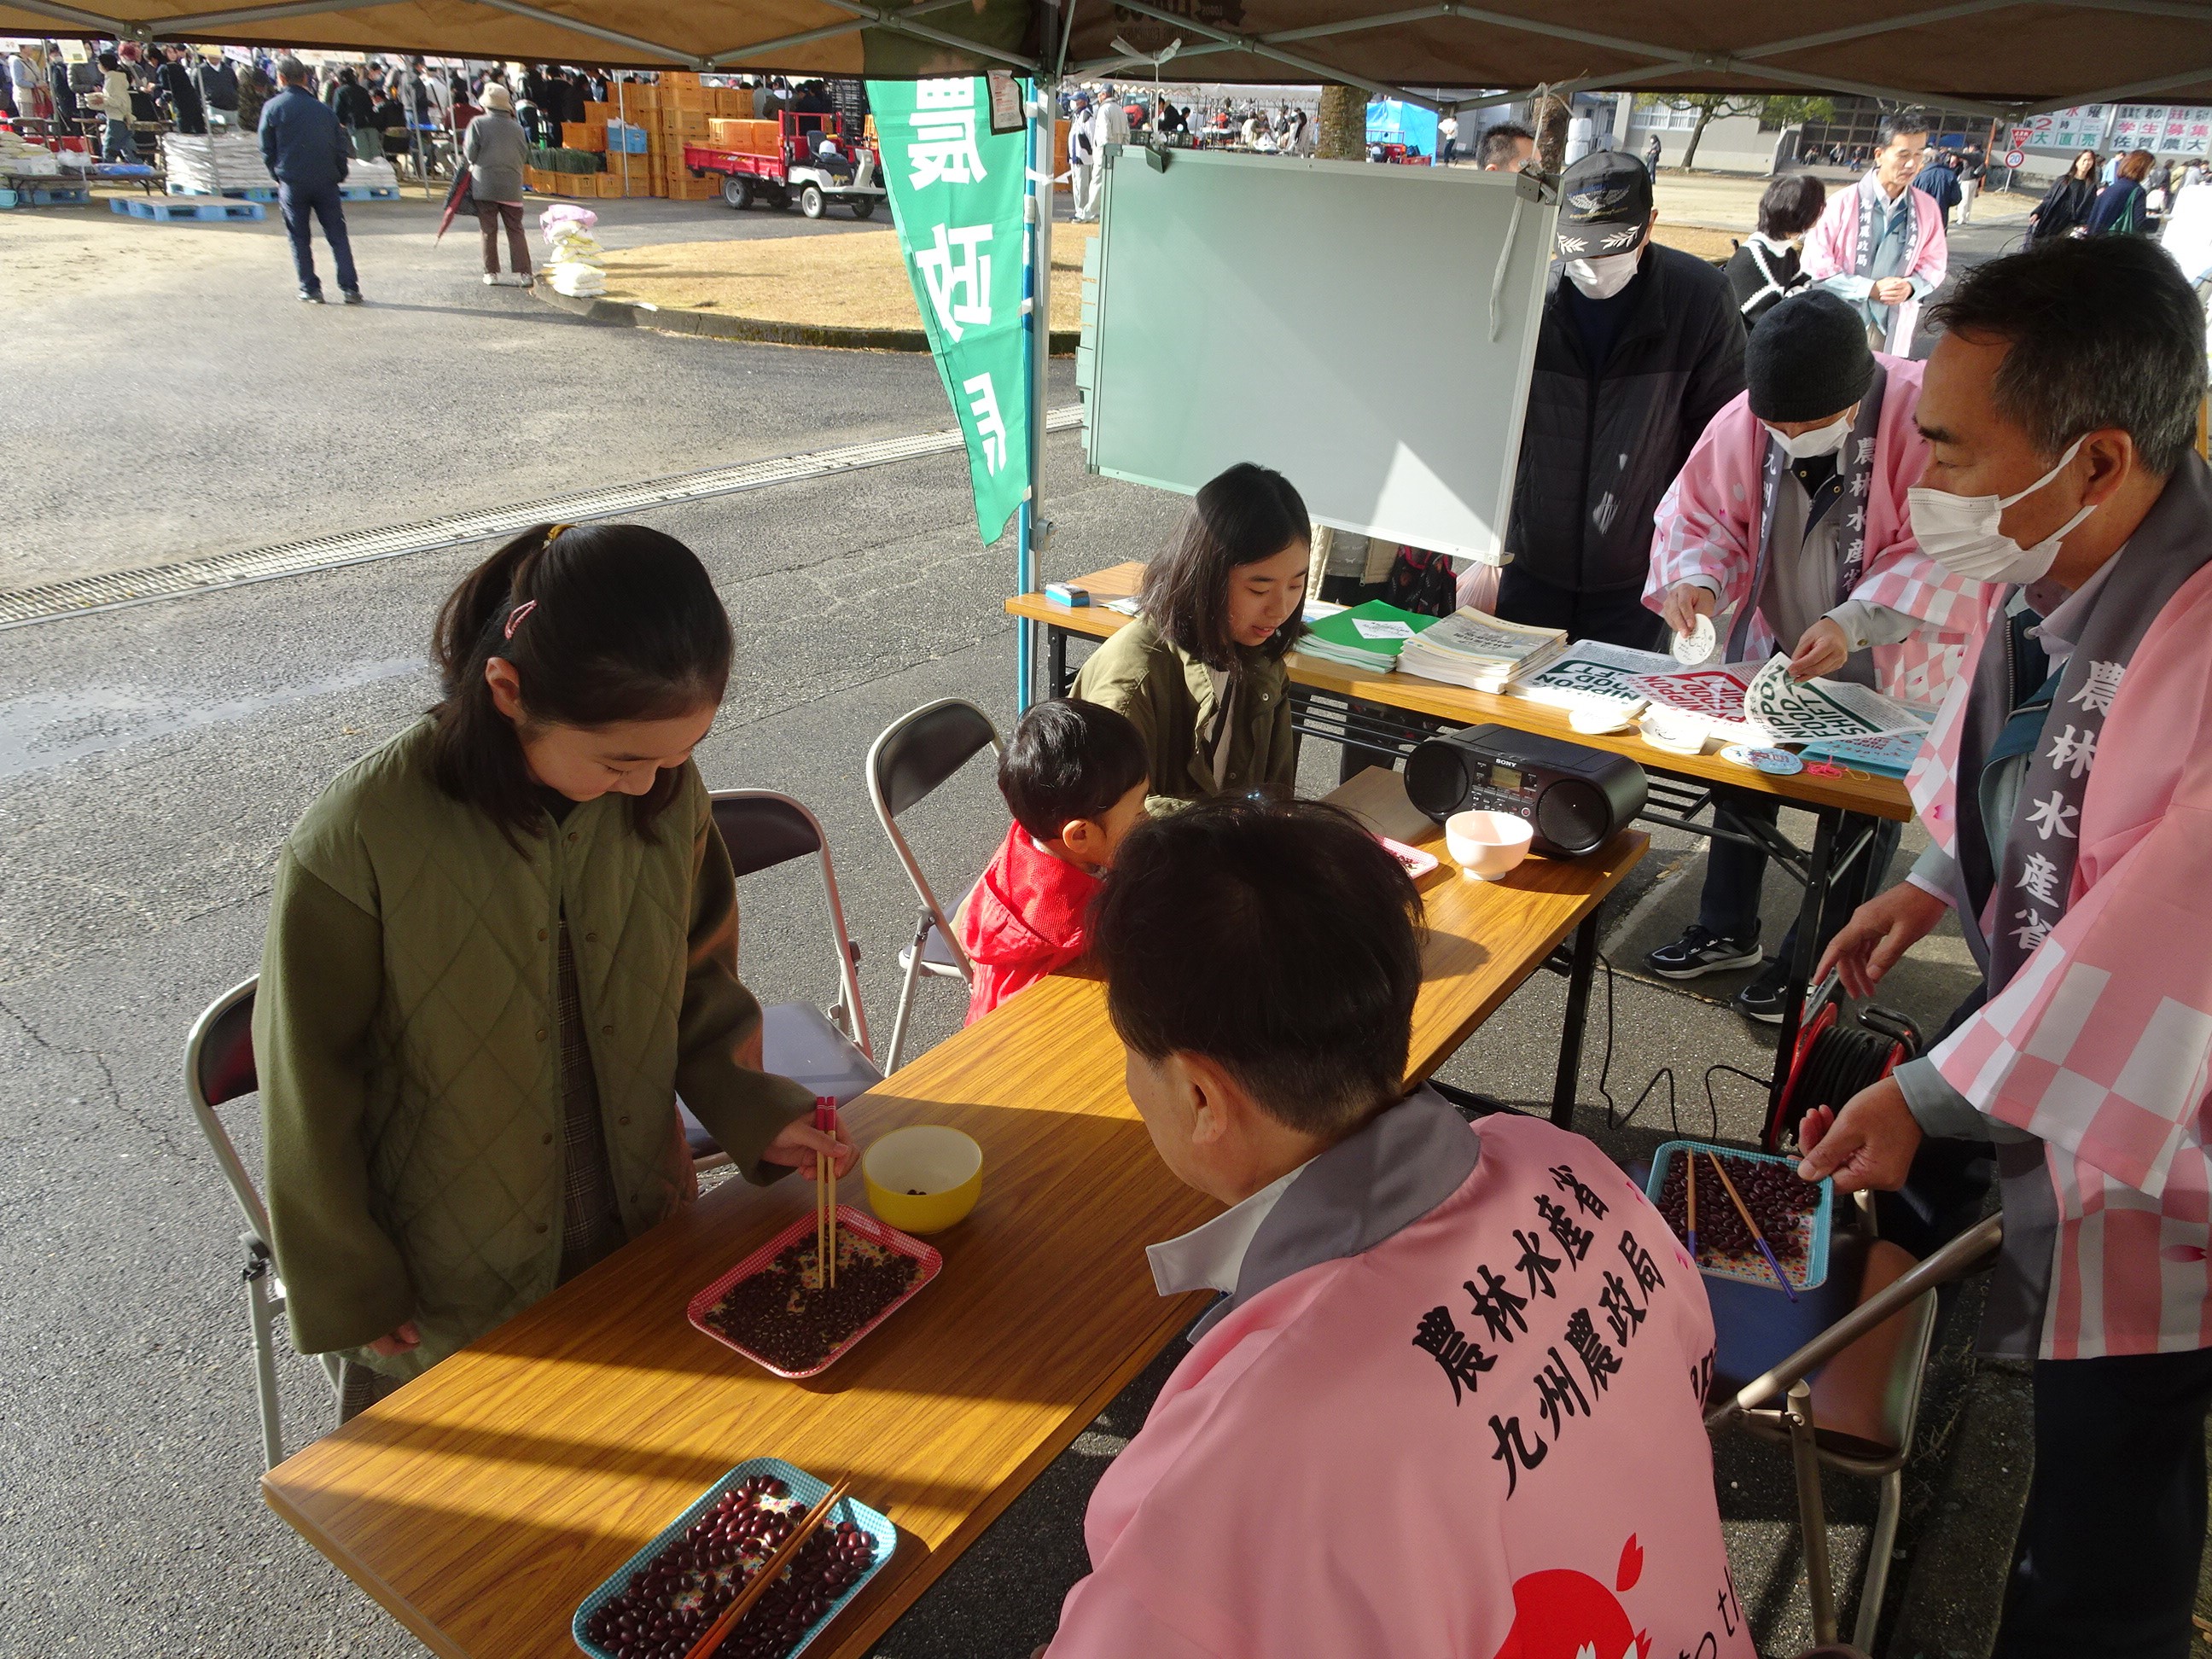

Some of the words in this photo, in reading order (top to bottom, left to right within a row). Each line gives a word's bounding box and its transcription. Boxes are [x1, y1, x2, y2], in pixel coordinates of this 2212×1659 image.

[2113, 137, 2204, 151] 佐賀農大
[2117, 122, 2210, 137] 学生募集
[2009, 154, 2021, 164] 20
[1856, 197, 1872, 267] 九州農政局
[1842, 436, 1877, 592] 農林水産省
[1534, 673, 1641, 701] NIPPON
[1639, 676, 1710, 711] NIPPON
[1680, 684, 1738, 710] FOOD
[1761, 663, 1814, 739] NIPPON
[1779, 697, 1840, 737] FOOD
[1796, 694, 1866, 736] SHIFT
[1495, 758, 1517, 768] SONY
[2008, 660, 2127, 951] 農林水産省
[1412, 1164, 1610, 1408] 農林水産省
[1487, 1229, 1667, 1502] 九州農政局
